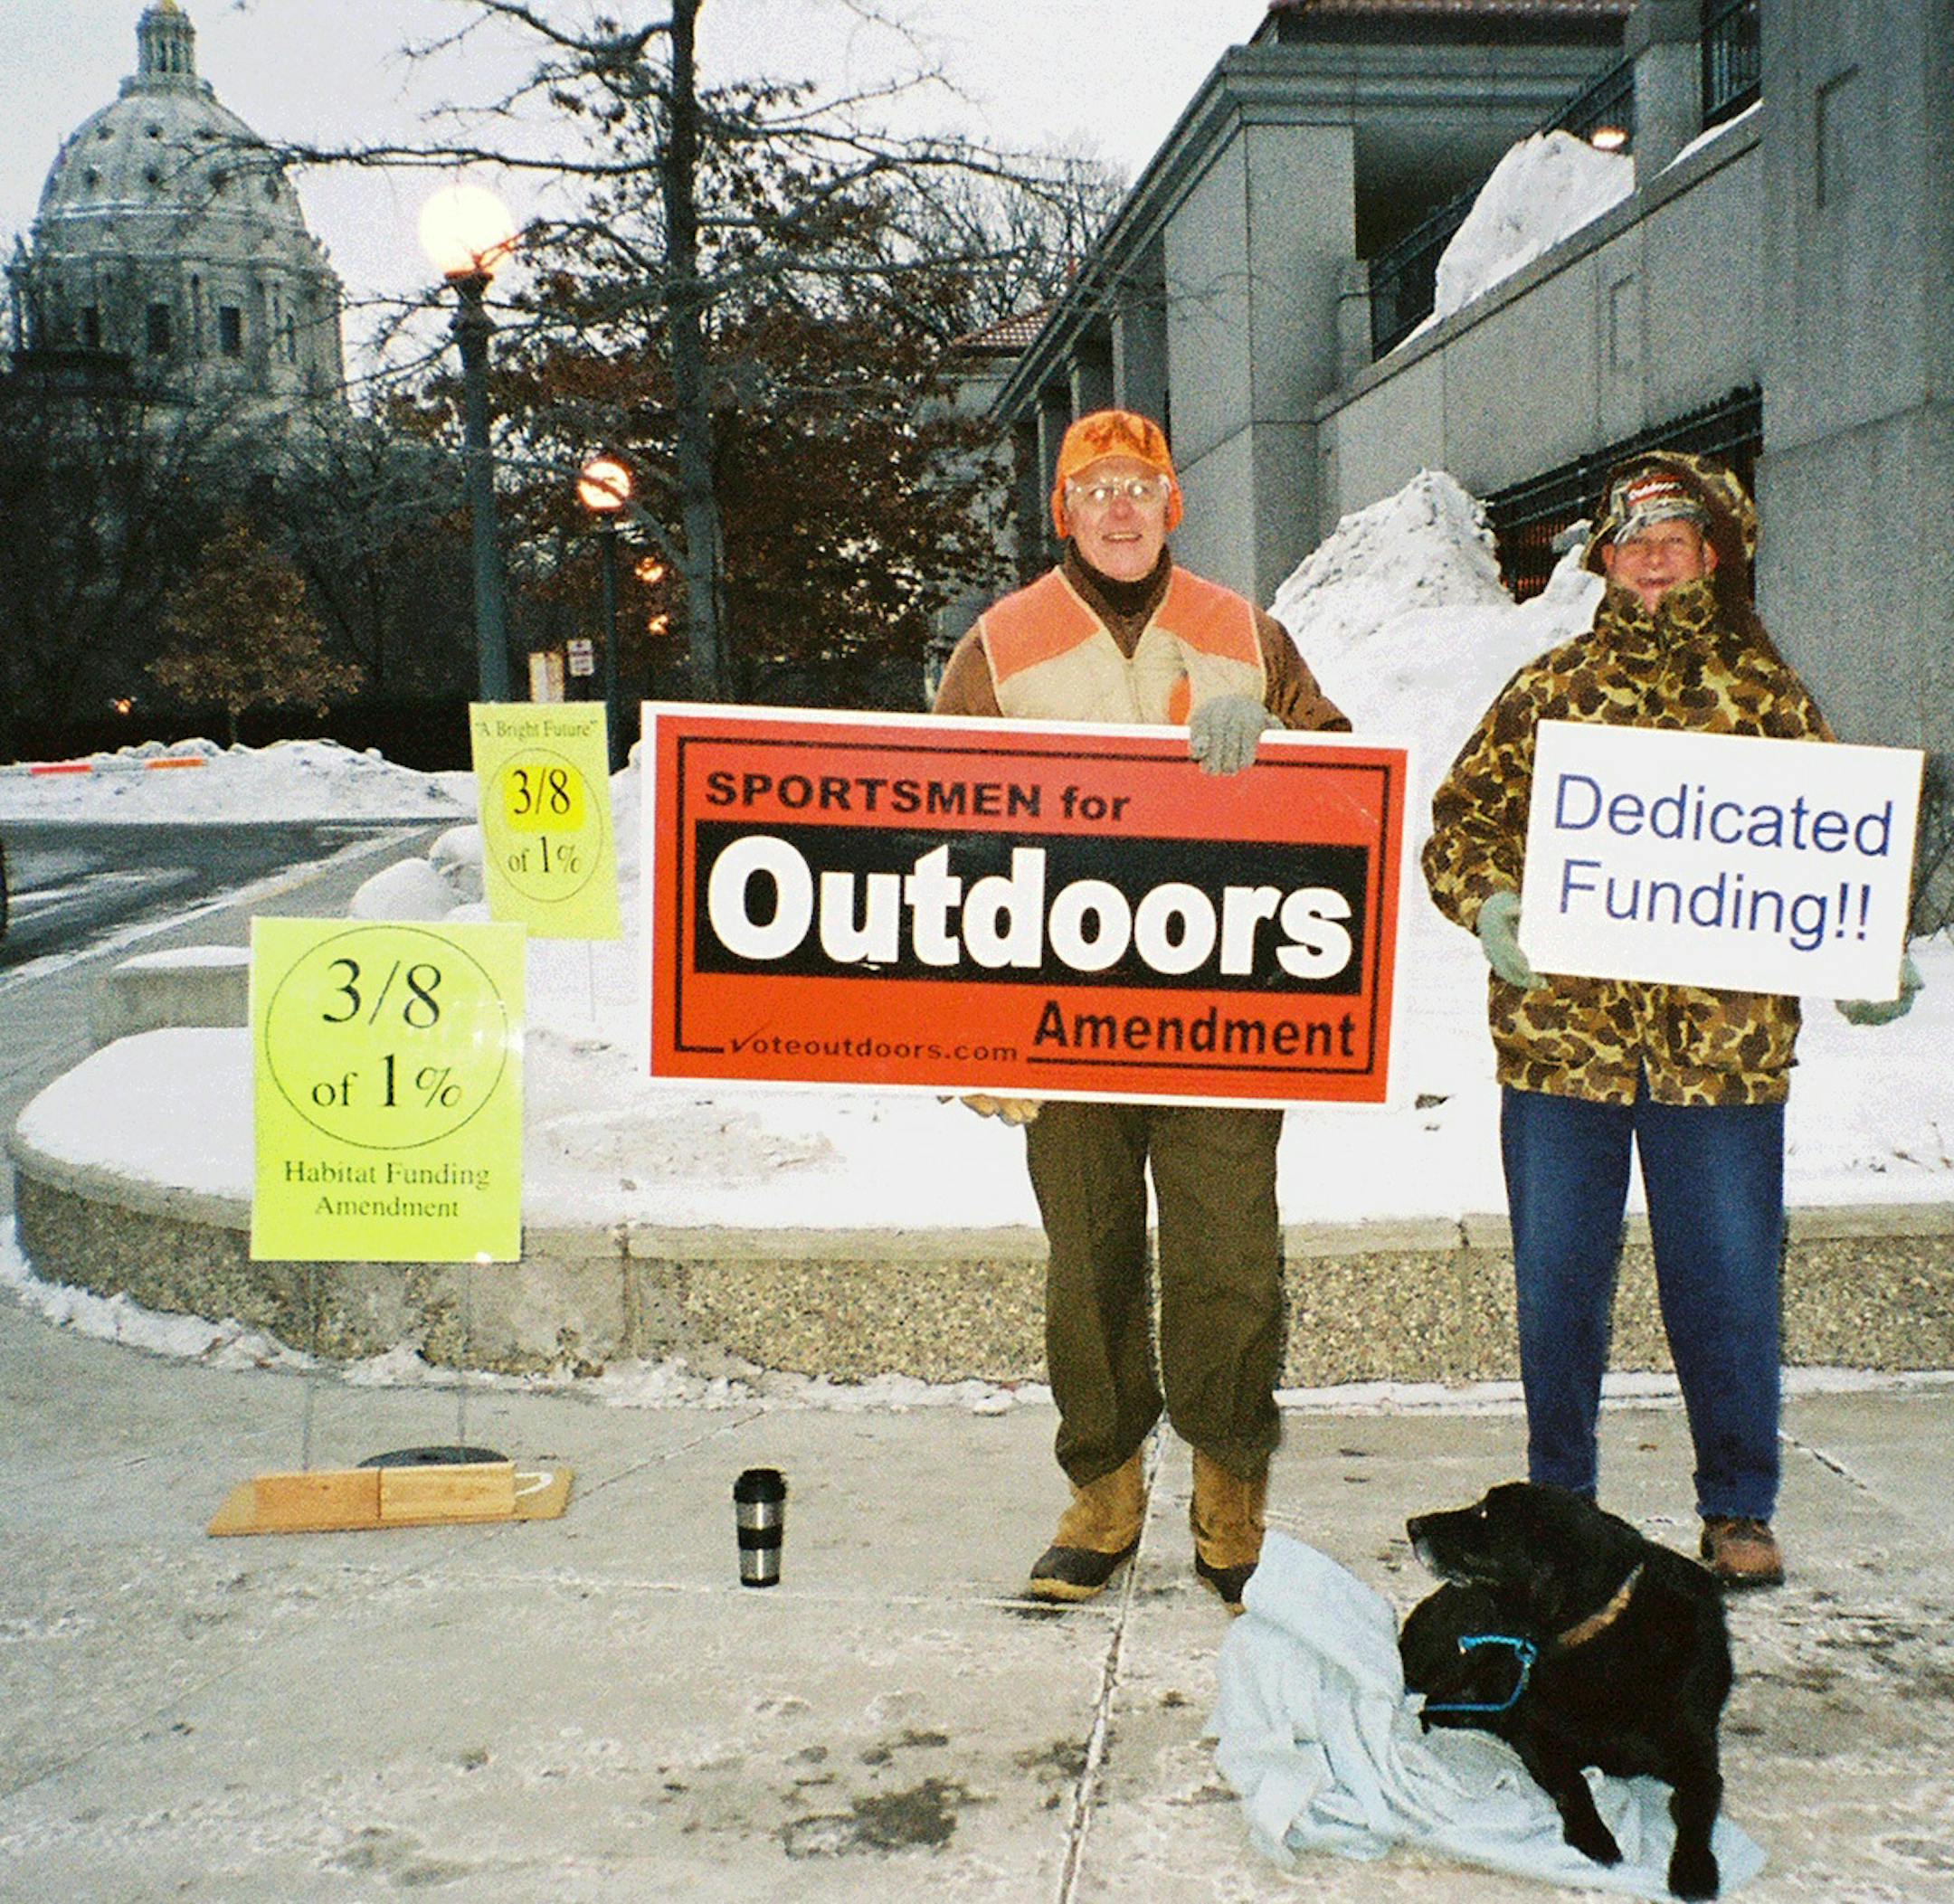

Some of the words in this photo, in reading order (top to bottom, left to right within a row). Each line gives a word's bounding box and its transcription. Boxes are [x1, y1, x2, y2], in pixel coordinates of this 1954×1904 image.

[497, 720, 539, 742] Bright
[513, 768, 571, 815] 3/8
[706, 771, 1041, 818] SPORTSMEN
[1061, 785, 1131, 821] for
[1554, 773, 1893, 857] Dedicated
[507, 848, 530, 873] of
[707, 834, 1352, 980] Outdoors
[1559, 858, 1872, 952] Funding!!
[322, 957, 441, 1029] 3/8
[1033, 999, 1355, 1057] Amendment
[311, 1071, 358, 1107] of
[284, 1160, 376, 1184] Habitat
[386, 1161, 491, 1191] Funding
[314, 1197, 459, 1218] Amendment
